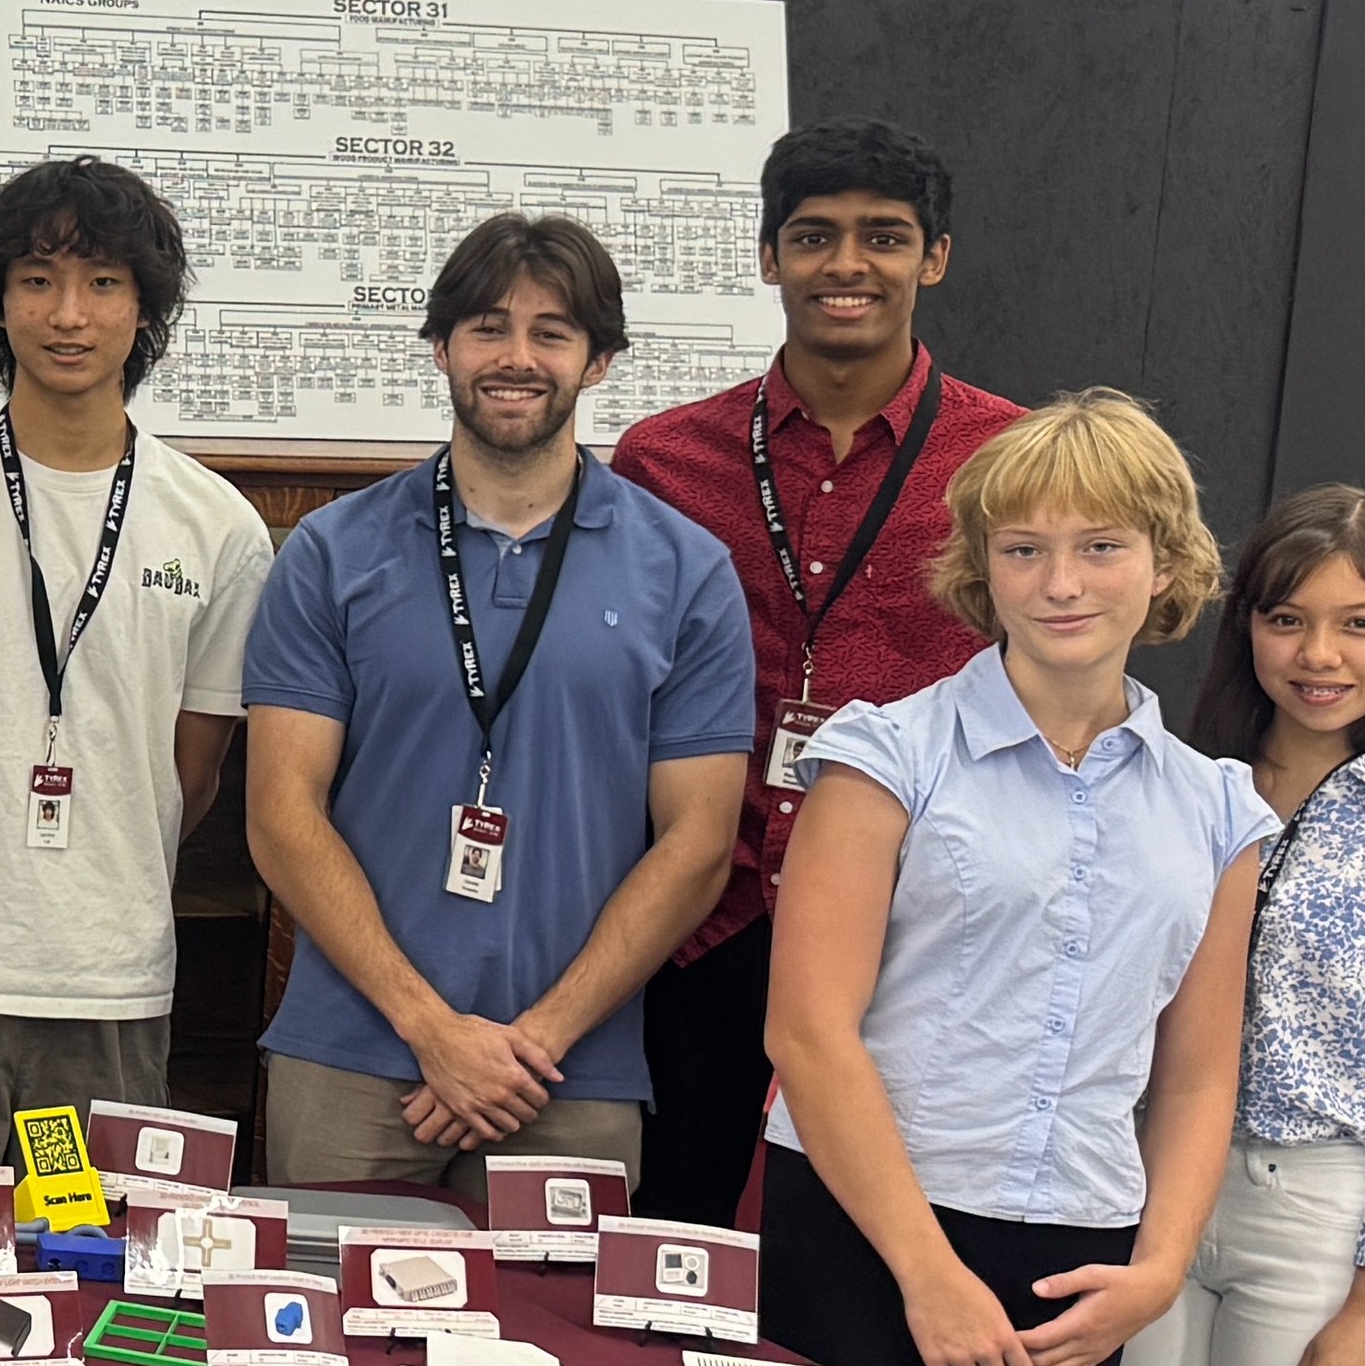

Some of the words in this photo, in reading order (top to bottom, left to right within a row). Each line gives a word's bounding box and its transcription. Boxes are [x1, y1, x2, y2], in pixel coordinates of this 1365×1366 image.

[426, 2, 448, 19] 31
[335, 137, 423, 156] SECTOR
[428, 141, 455, 157] 32
[752, 414, 762, 454] TYREX
[9, 482, 26, 523] TYREX
[110, 478, 127, 519] TYREX
[760, 478, 776, 523] TYREX
[440, 505, 452, 546] TYREX
[91, 545, 111, 586] TYREX
[779, 547, 800, 591] TYREX
[448, 572, 466, 617] TYREX
[460, 640, 478, 685] TYREX
[43, 1195, 67, 1206] Scan
[68, 1192, 92, 1203] Here
